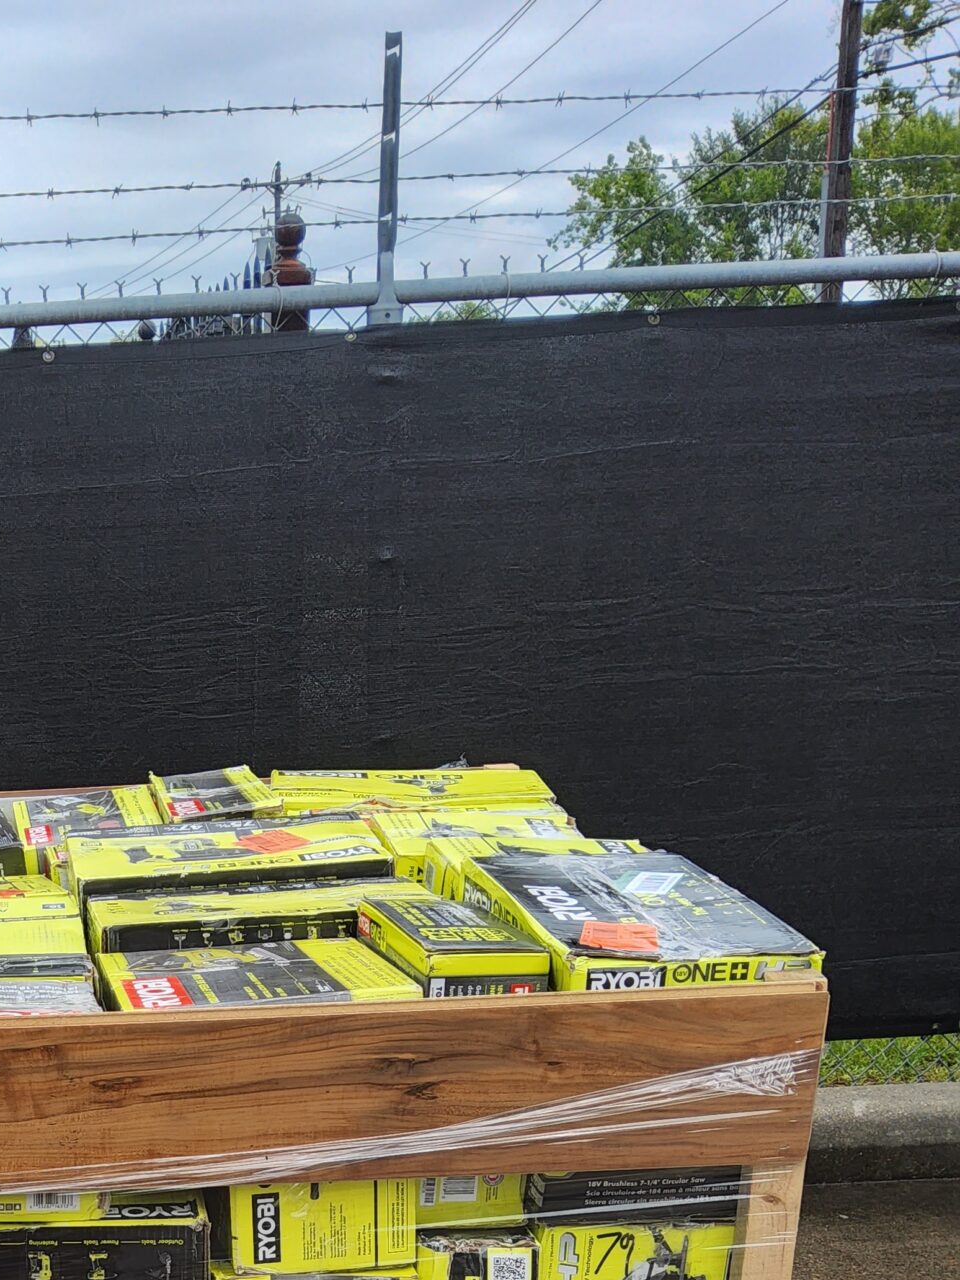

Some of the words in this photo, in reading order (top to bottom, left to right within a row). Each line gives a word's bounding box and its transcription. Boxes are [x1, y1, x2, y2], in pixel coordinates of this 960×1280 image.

[304, 846, 377, 861] RYOBI
[522, 885, 597, 921] RYOBI
[592, 968, 664, 991] RYOBI
[131, 977, 182, 1008] RYOBI
[603, 1179, 638, 1188] Brushless
[662, 1176, 690, 1186] Circular
[691, 1176, 706, 1184] Saw
[586, 1189, 601, 1197] Scie
[105, 1202, 194, 1219] RYOB
[257, 1197, 277, 1261] RYOBI
